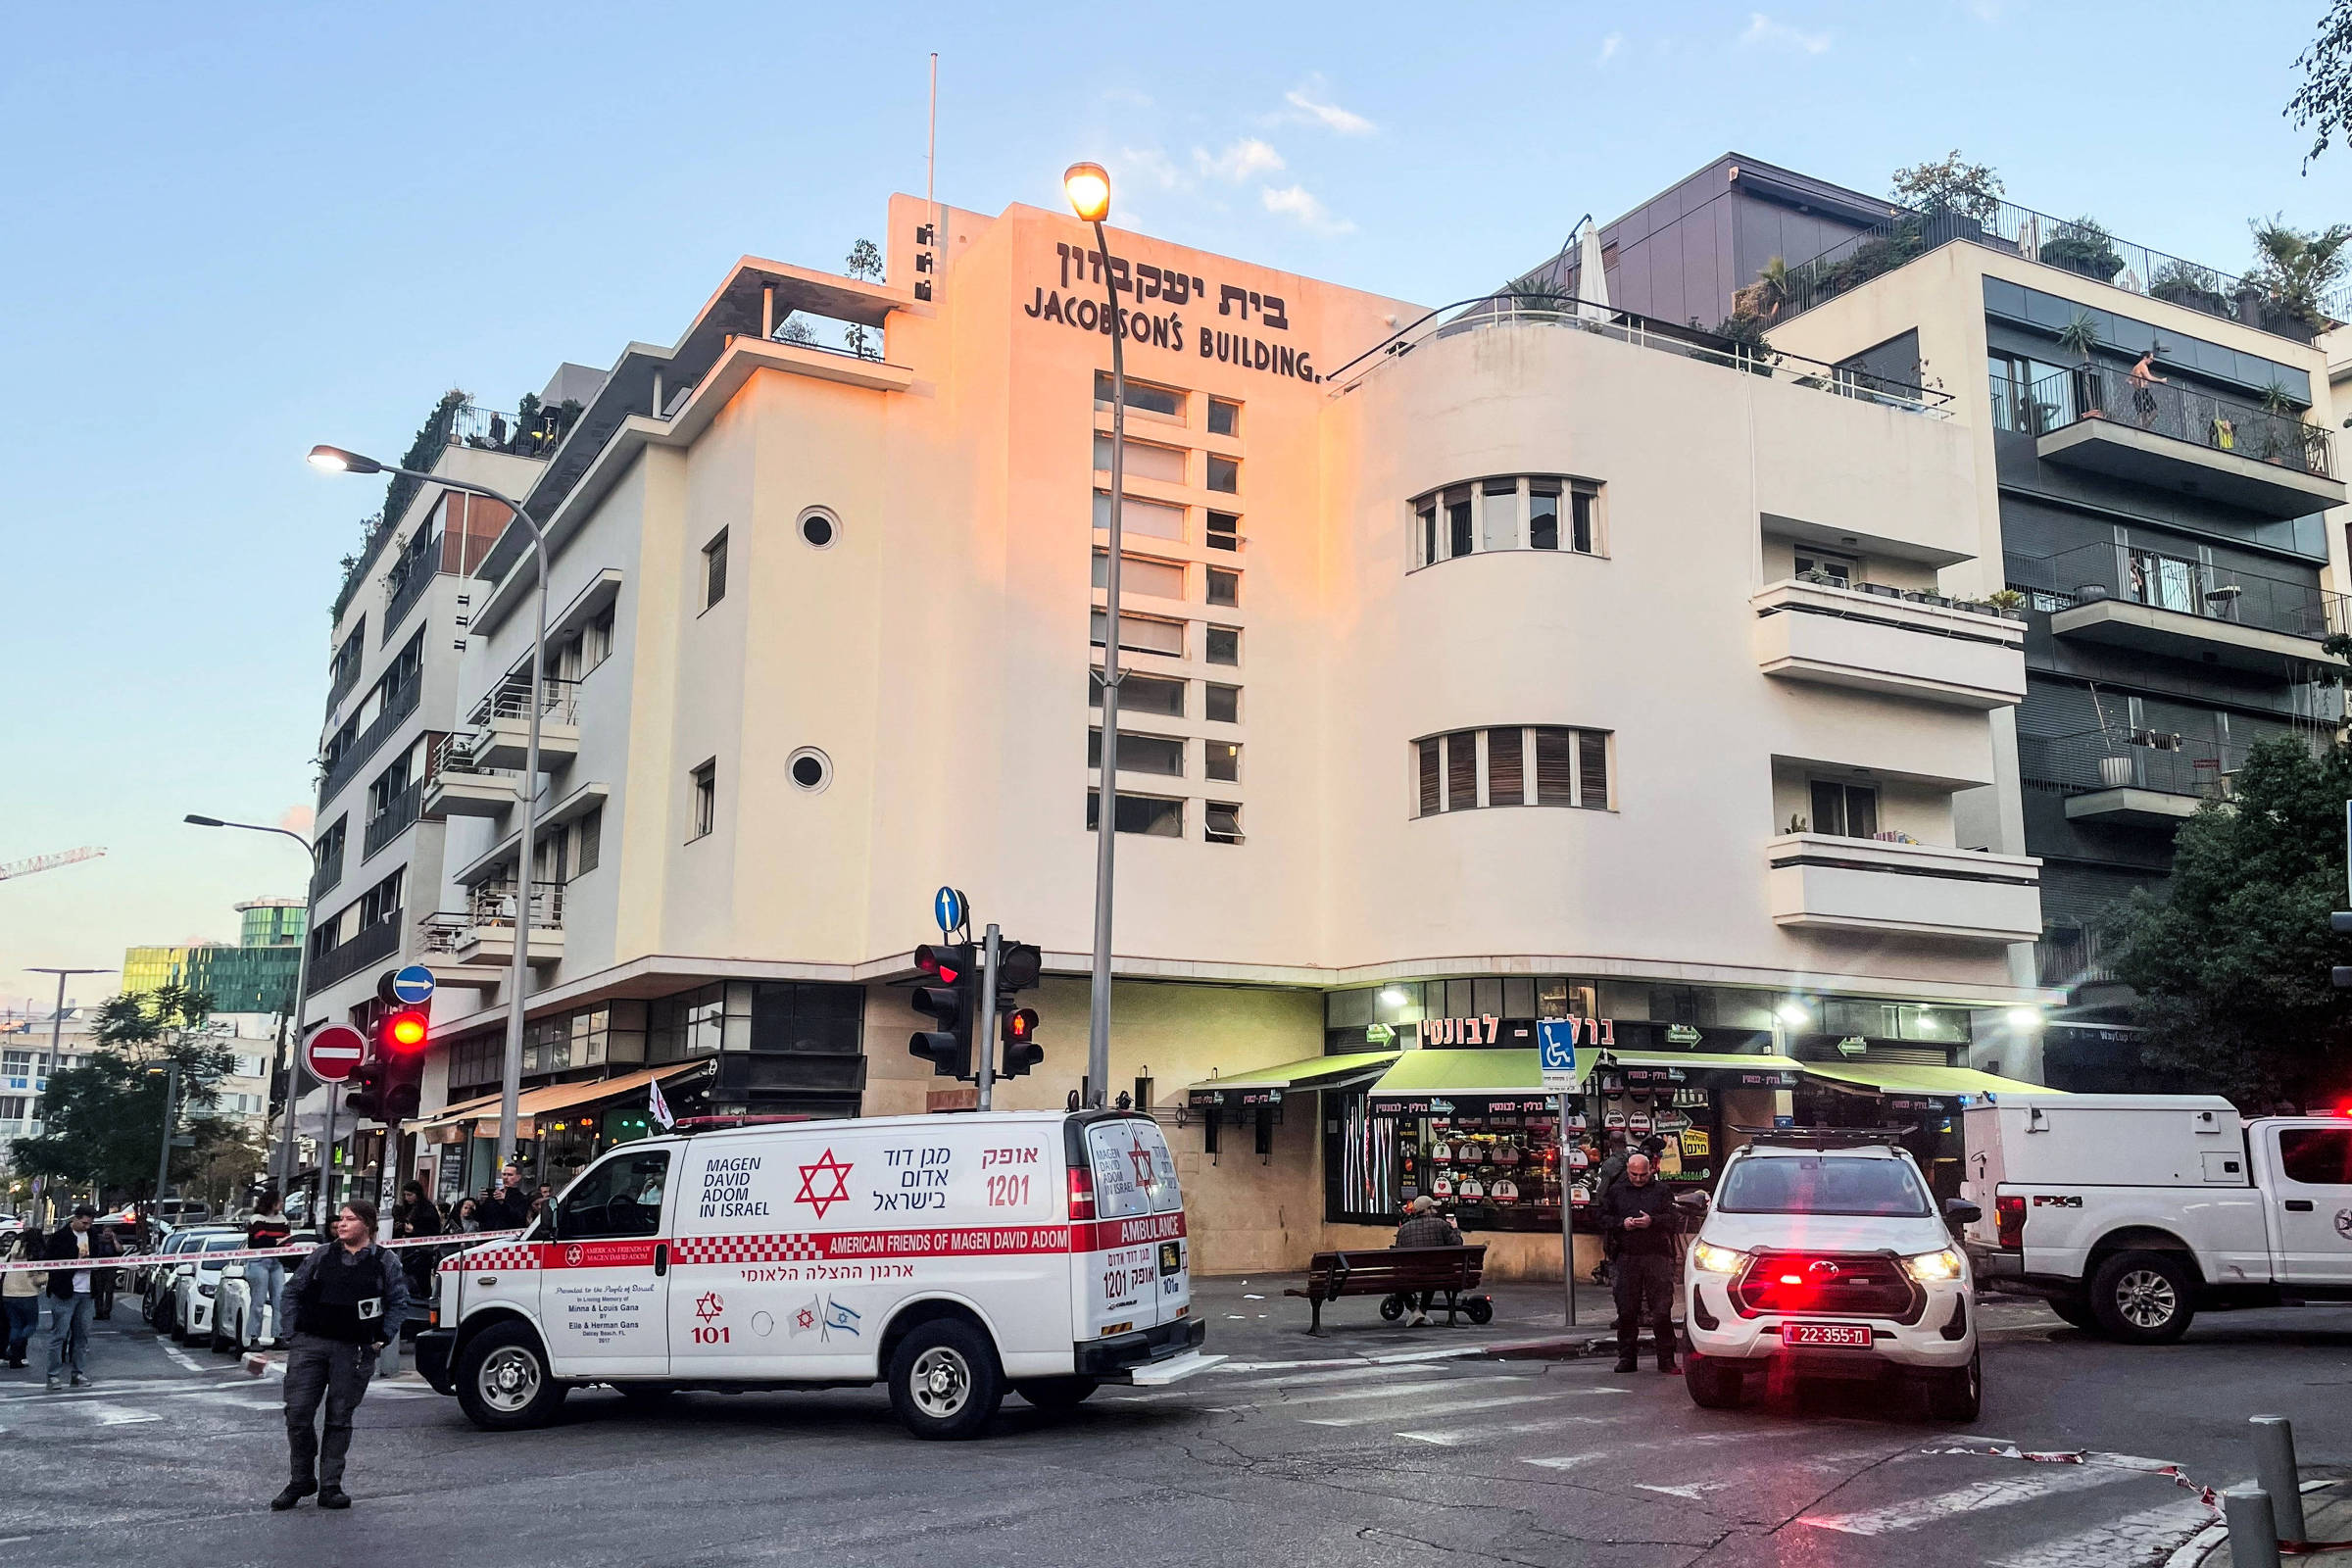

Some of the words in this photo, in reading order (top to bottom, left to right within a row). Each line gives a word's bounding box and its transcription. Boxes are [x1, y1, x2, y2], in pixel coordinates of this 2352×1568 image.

[1056, 242, 1204, 305] יעקבזון
[1218, 283, 1288, 330] בית
[1024, 286, 1184, 352] JACOBSON'S
[1415, 1012, 1499, 1050] לבונטין
[1544, 1013, 1615, 1046] ברל
[1408, 1102, 1428, 1113] ברלין
[1489, 1102, 1515, 1113] לבונטין
[1524, 1102, 1544, 1112] ברלין
[1096, 1148, 1120, 1160] MAGEN
[1684, 1142, 1707, 1155] חינם!
[706, 1156, 761, 1172] MAGEN
[883, 1149, 913, 1166] דוד
[920, 1148, 951, 1168] מגן
[981, 1147, 1039, 1169] אופק
[1100, 1159, 1120, 1171] DAVID
[704, 1172, 751, 1188] DAVID
[901, 1168, 949, 1188] אדום
[1102, 1170, 1124, 1184] ADOM
[702, 1187, 749, 1202] ADOM
[987, 1174, 1030, 1207] 1201
[1113, 1181, 1134, 1195] ISRAEL
[873, 1190, 946, 1211] בישראל
[699, 1203, 715, 1218] IN
[720, 1201, 770, 1217] ISRAEL
[1120, 1215, 1180, 1244] AMBULANCE
[829, 1236, 884, 1255] AMERICAN
[887, 1234, 931, 1252] FRIENDS
[933, 1233, 949, 1250] OF
[951, 1232, 992, 1250] MAGEN
[994, 1230, 1029, 1250] DAVID
[1031, 1229, 1068, 1249] ADOM
[1108, 1252, 1125, 1267] אדום
[1126, 1250, 1138, 1263] דוד
[1139, 1248, 1150, 1264] מגן
[740, 1266, 799, 1282] הלאומי
[806, 1265, 862, 1281] ההצלה
[870, 1264, 913, 1281] ארגון
[1131, 1266, 1154, 1291] אופק
[1103, 1269, 1127, 1299] 1201
[691, 1326, 731, 1344] 101
